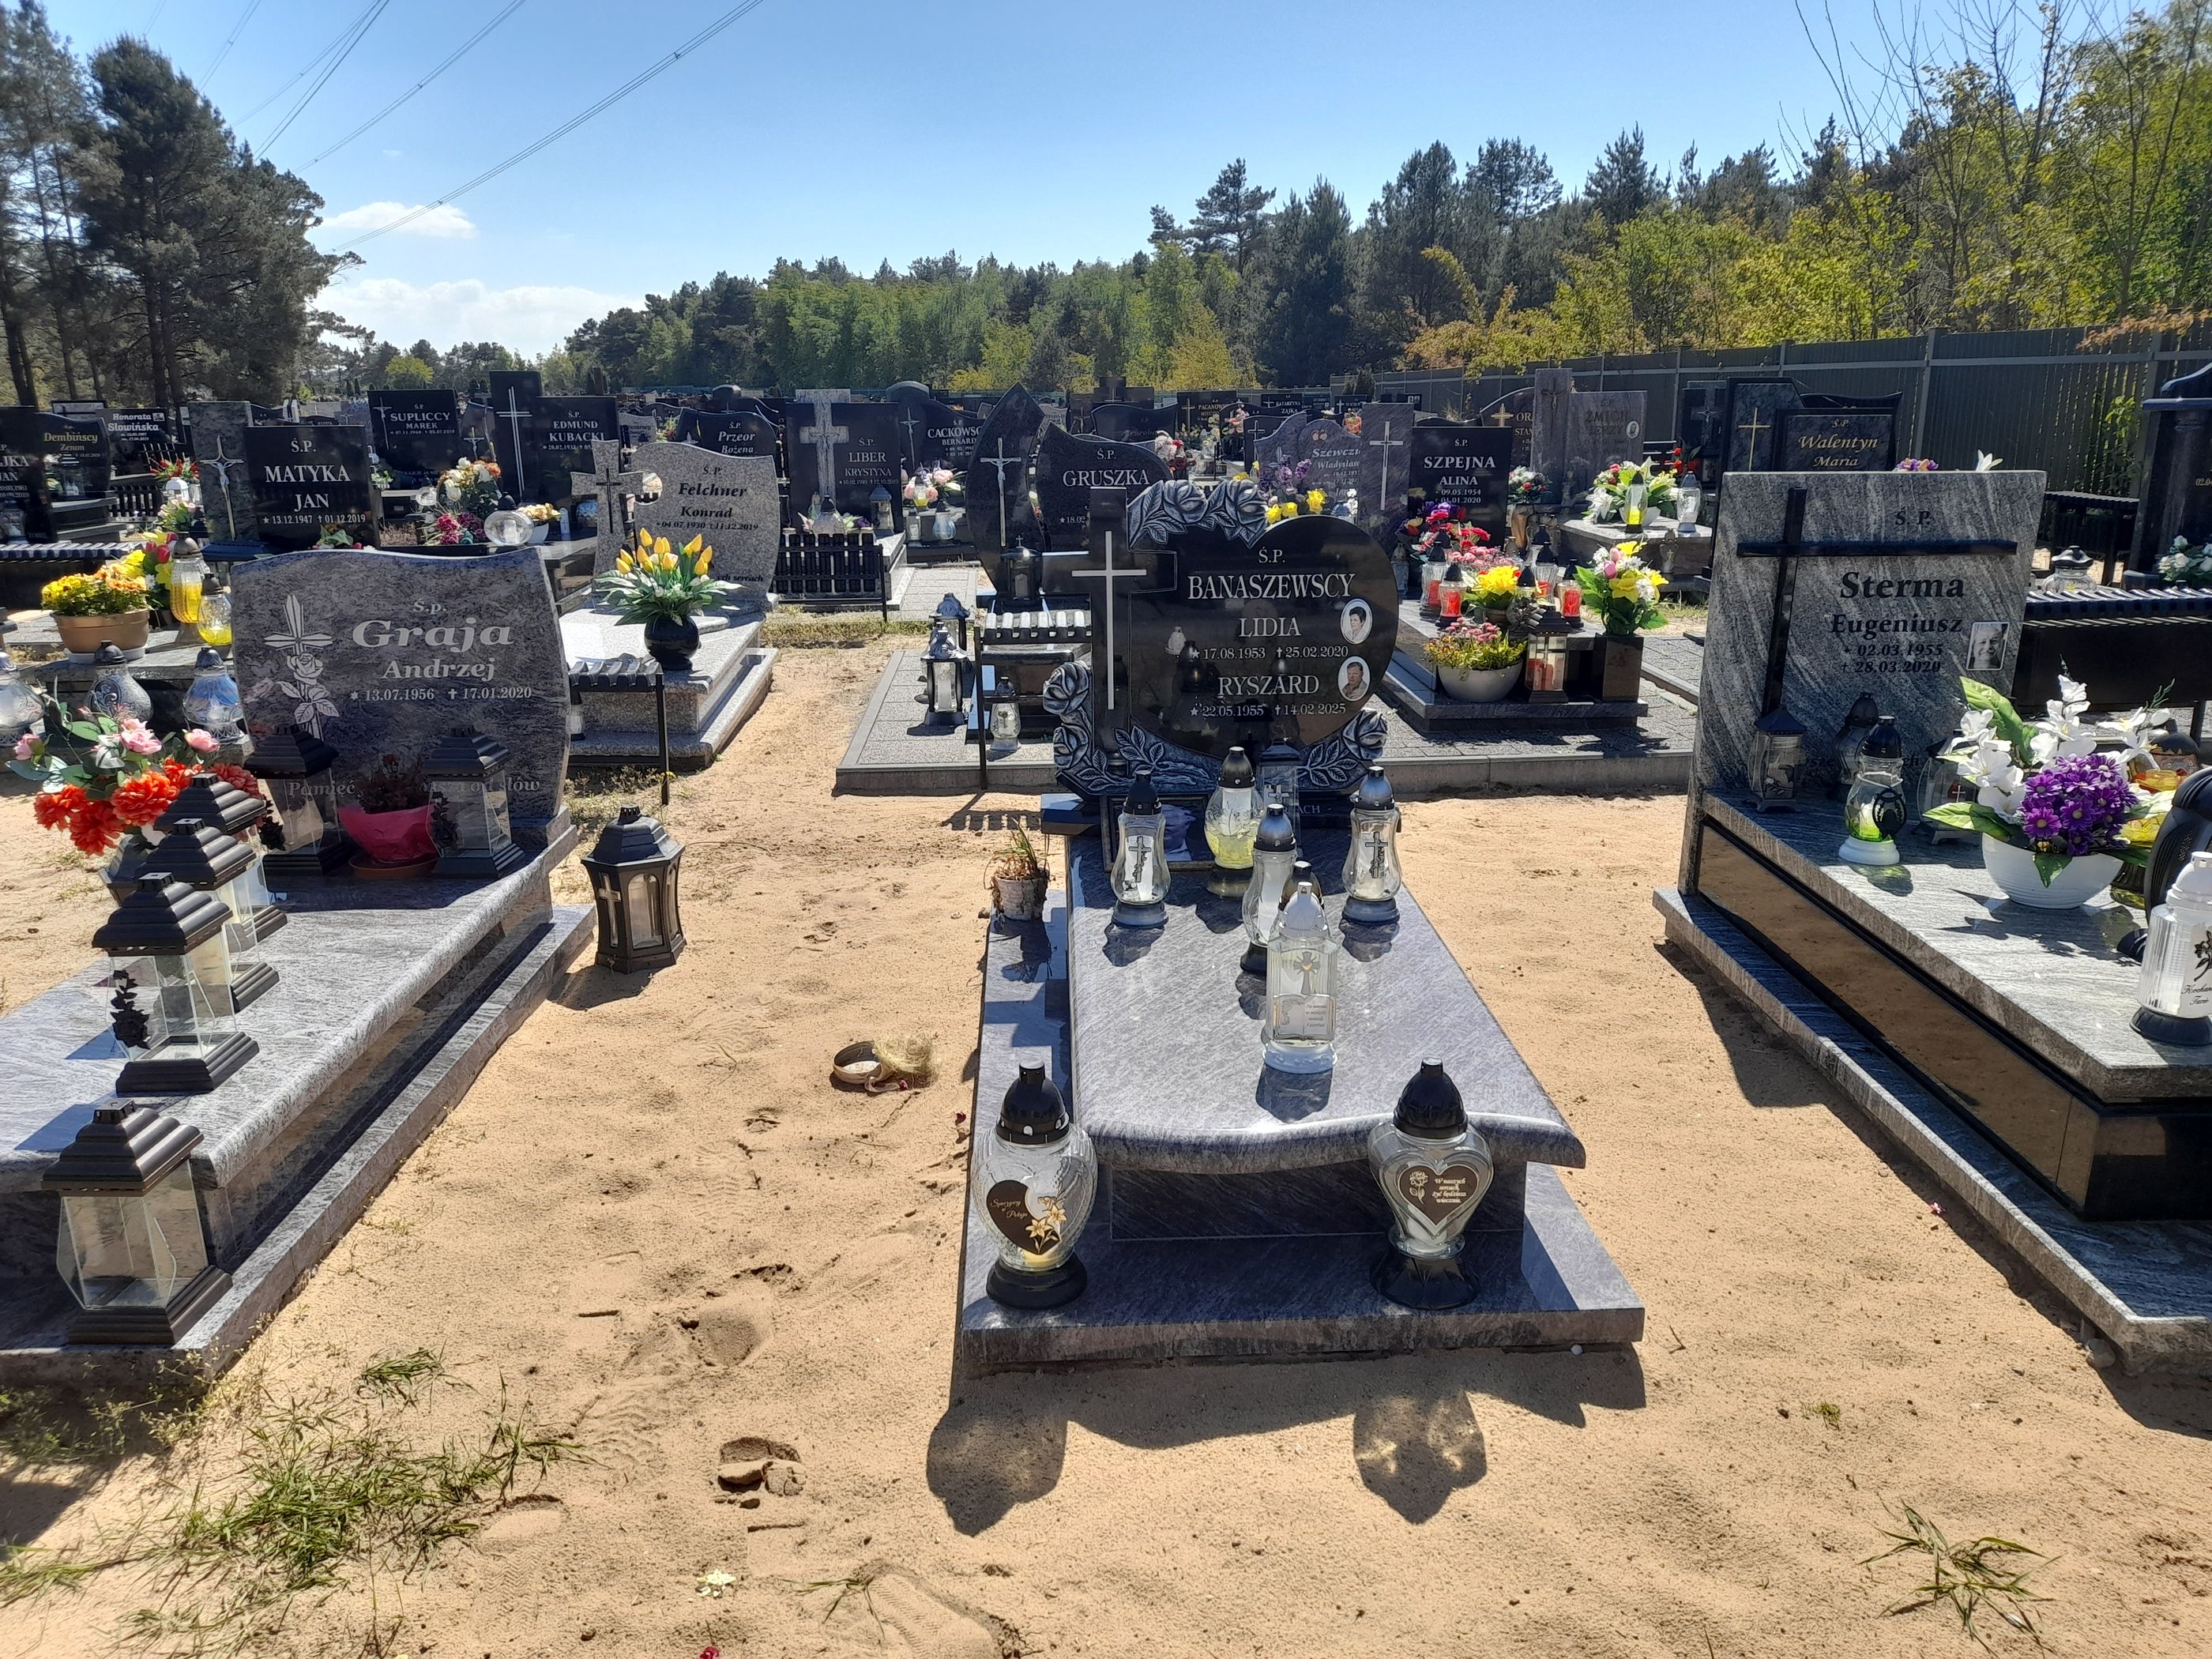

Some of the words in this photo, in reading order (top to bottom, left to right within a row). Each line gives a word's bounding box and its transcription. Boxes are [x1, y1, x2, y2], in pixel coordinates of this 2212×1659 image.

[390, 412, 450, 422] SUPLICCY
[44, 432, 98, 444] Dembińscy
[549, 432, 604, 442] KUBACKI
[718, 431, 755, 442] Przeor
[927, 427, 982, 438] CACKOWSC
[291, 438, 317, 453] Ś.P.
[1454, 438, 1468, 446] Ś.P.
[1798, 434, 1879, 453] Walentyn
[721, 445, 754, 454] Bożena
[1097, 448, 1117, 460] Ś.P.
[0, 456, 30, 467] JKA
[848, 452, 886, 462] LIBER
[1424, 457, 1496, 471] SZPEJNA
[1813, 456, 1859, 467] Maria
[264, 465, 352, 483] MATYKA
[1063, 469, 1150, 487] GRUSZKA
[1439, 476, 1478, 485] ALINA
[678, 483, 747, 497] Felchner
[294, 494, 329, 512] JAN
[680, 506, 733, 518] Konrad
[273, 515, 313, 525] 13.12.1947
[325, 514, 366, 524] 01.12.2019
[1258, 547, 1286, 563] Ś.P.
[1187, 574, 1356, 600] BANASZEWSCY
[1840, 572, 1965, 598] Sterma
[413, 598, 448, 614] Ś.p.
[1239, 617, 1302, 638] LIDIA
[1831, 614, 1963, 641] Eugeniusz
[352, 618, 515, 653] Graja
[1203, 647, 1266, 660] 17.08.1953
[1285, 645, 1349, 658] 25.02.2020
[1857, 644, 1943, 656] 02.03.1955
[381, 658, 495, 682] Andrzej
[1856, 661, 1941, 672] 28.03.2020
[1218, 675, 1319, 696] RYSZARD
[364, 688, 435, 702] 13.07.1956
[462, 686, 532, 700] 17.01.2020
[1202, 705, 1264, 717] 22.05.1955
[1284, 703, 1346, 715] 14.02.2025
